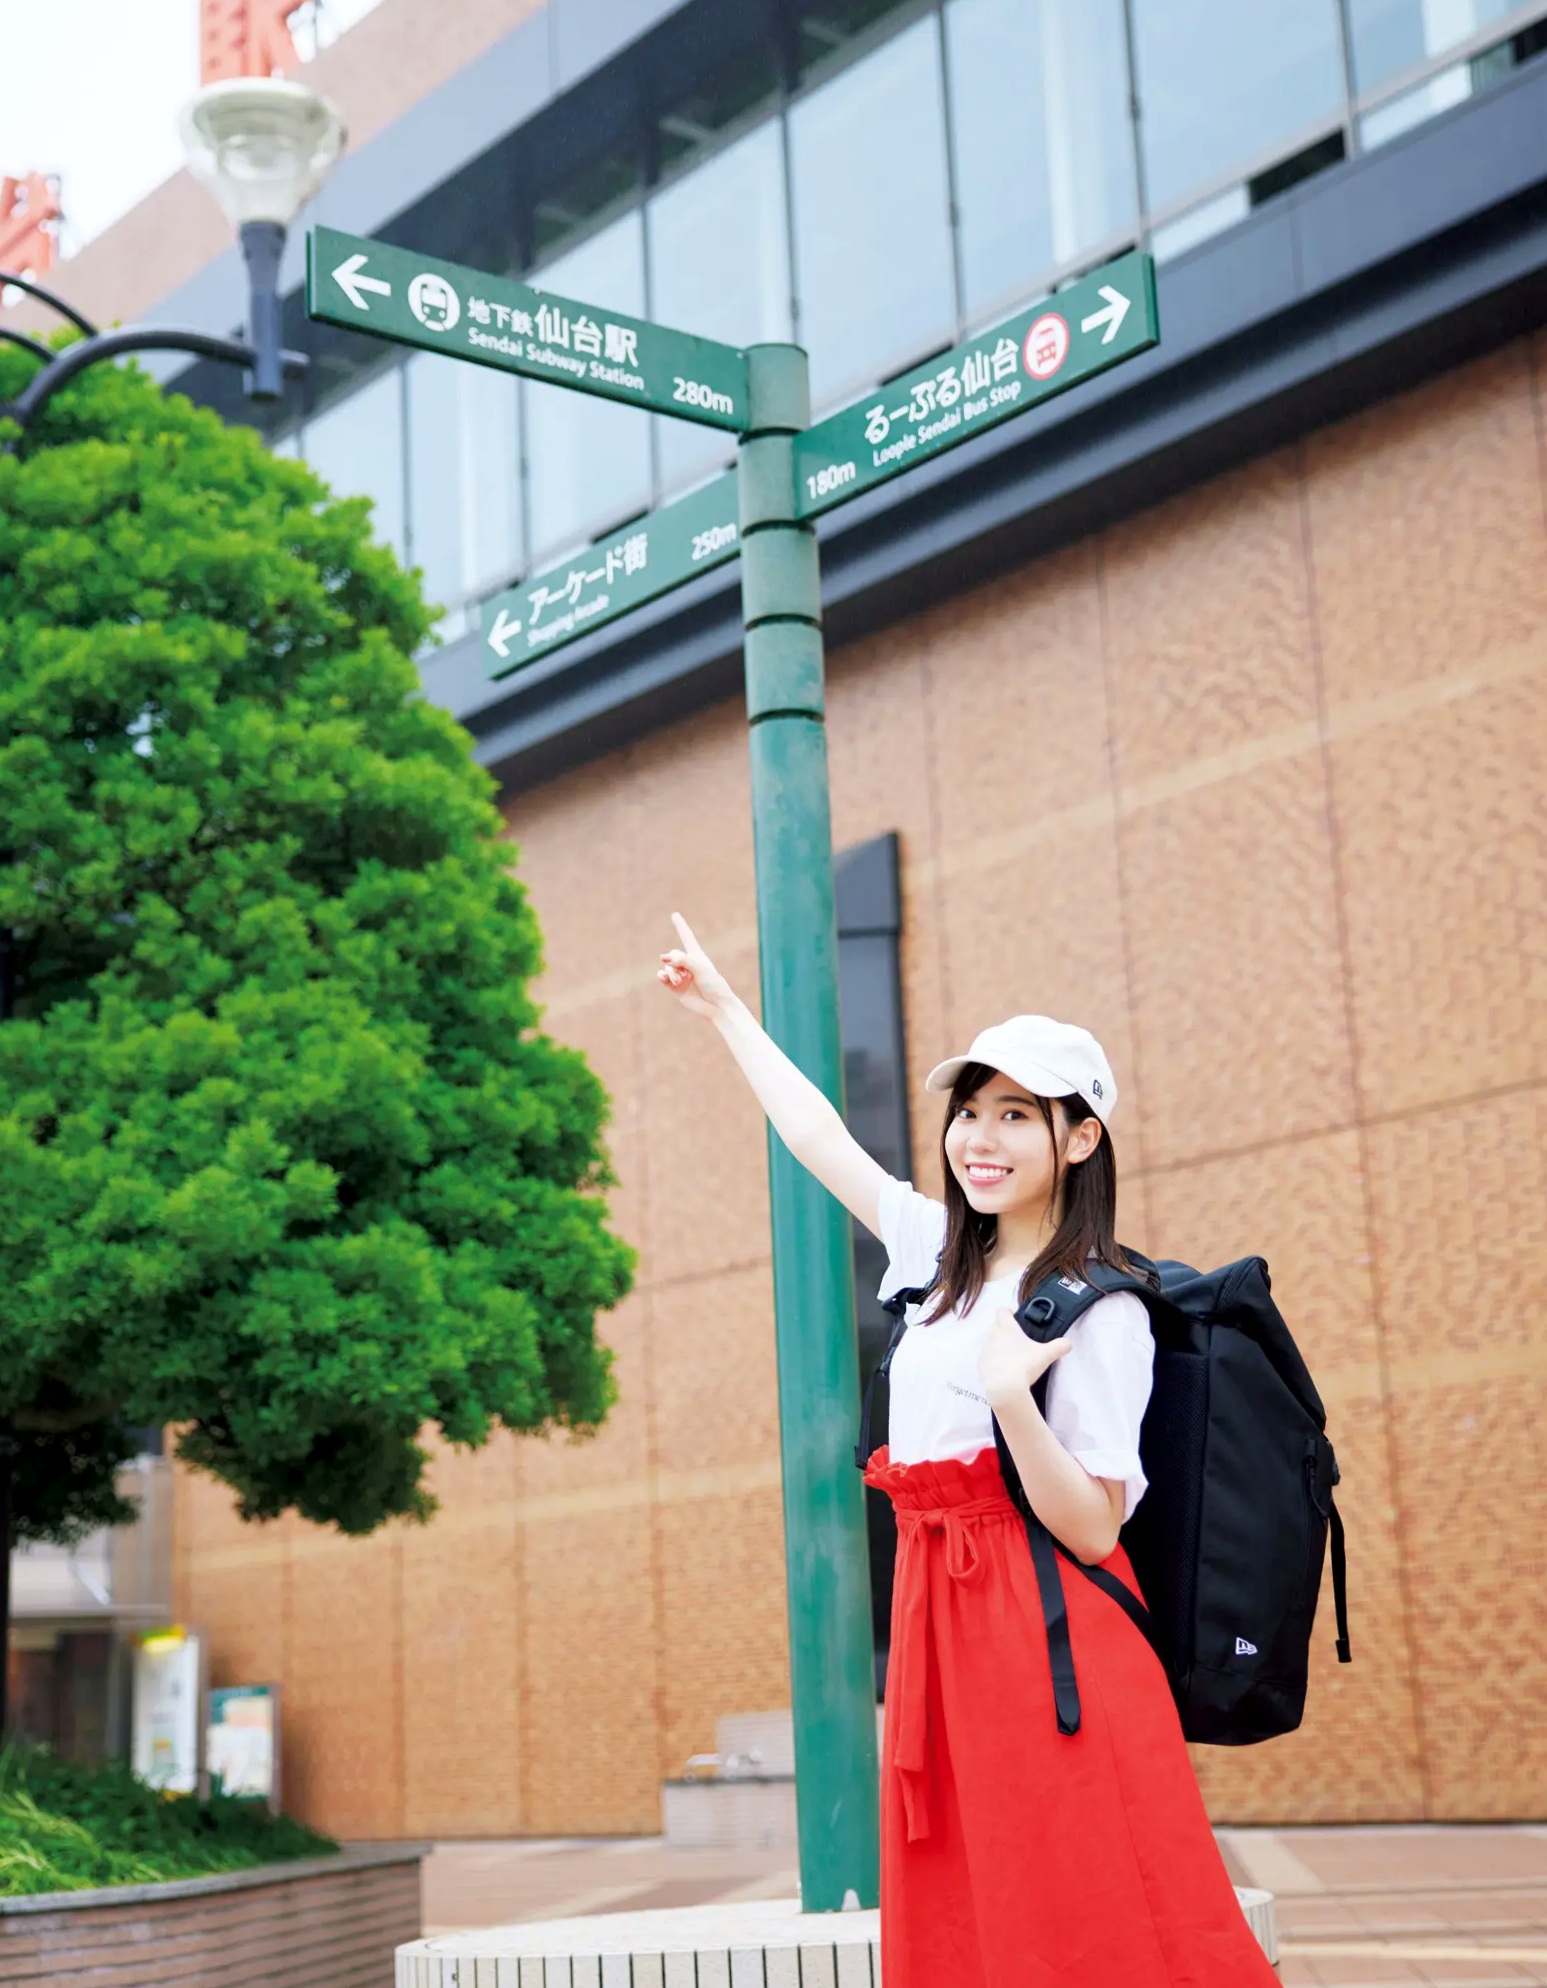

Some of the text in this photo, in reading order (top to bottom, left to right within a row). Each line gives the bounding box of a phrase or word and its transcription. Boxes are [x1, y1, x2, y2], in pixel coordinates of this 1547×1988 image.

[468, 327, 645, 391] Sendai Subway Station
[672, 376, 734, 415] 280m
[864, 338, 1020, 445] るーぷる仙台
[872, 380, 1022, 467] Loople Sendai Bus Stop
[806, 460, 857, 500] 180m
[692, 522, 737, 561] 250m
[527, 533, 648, 625] アーケード街
